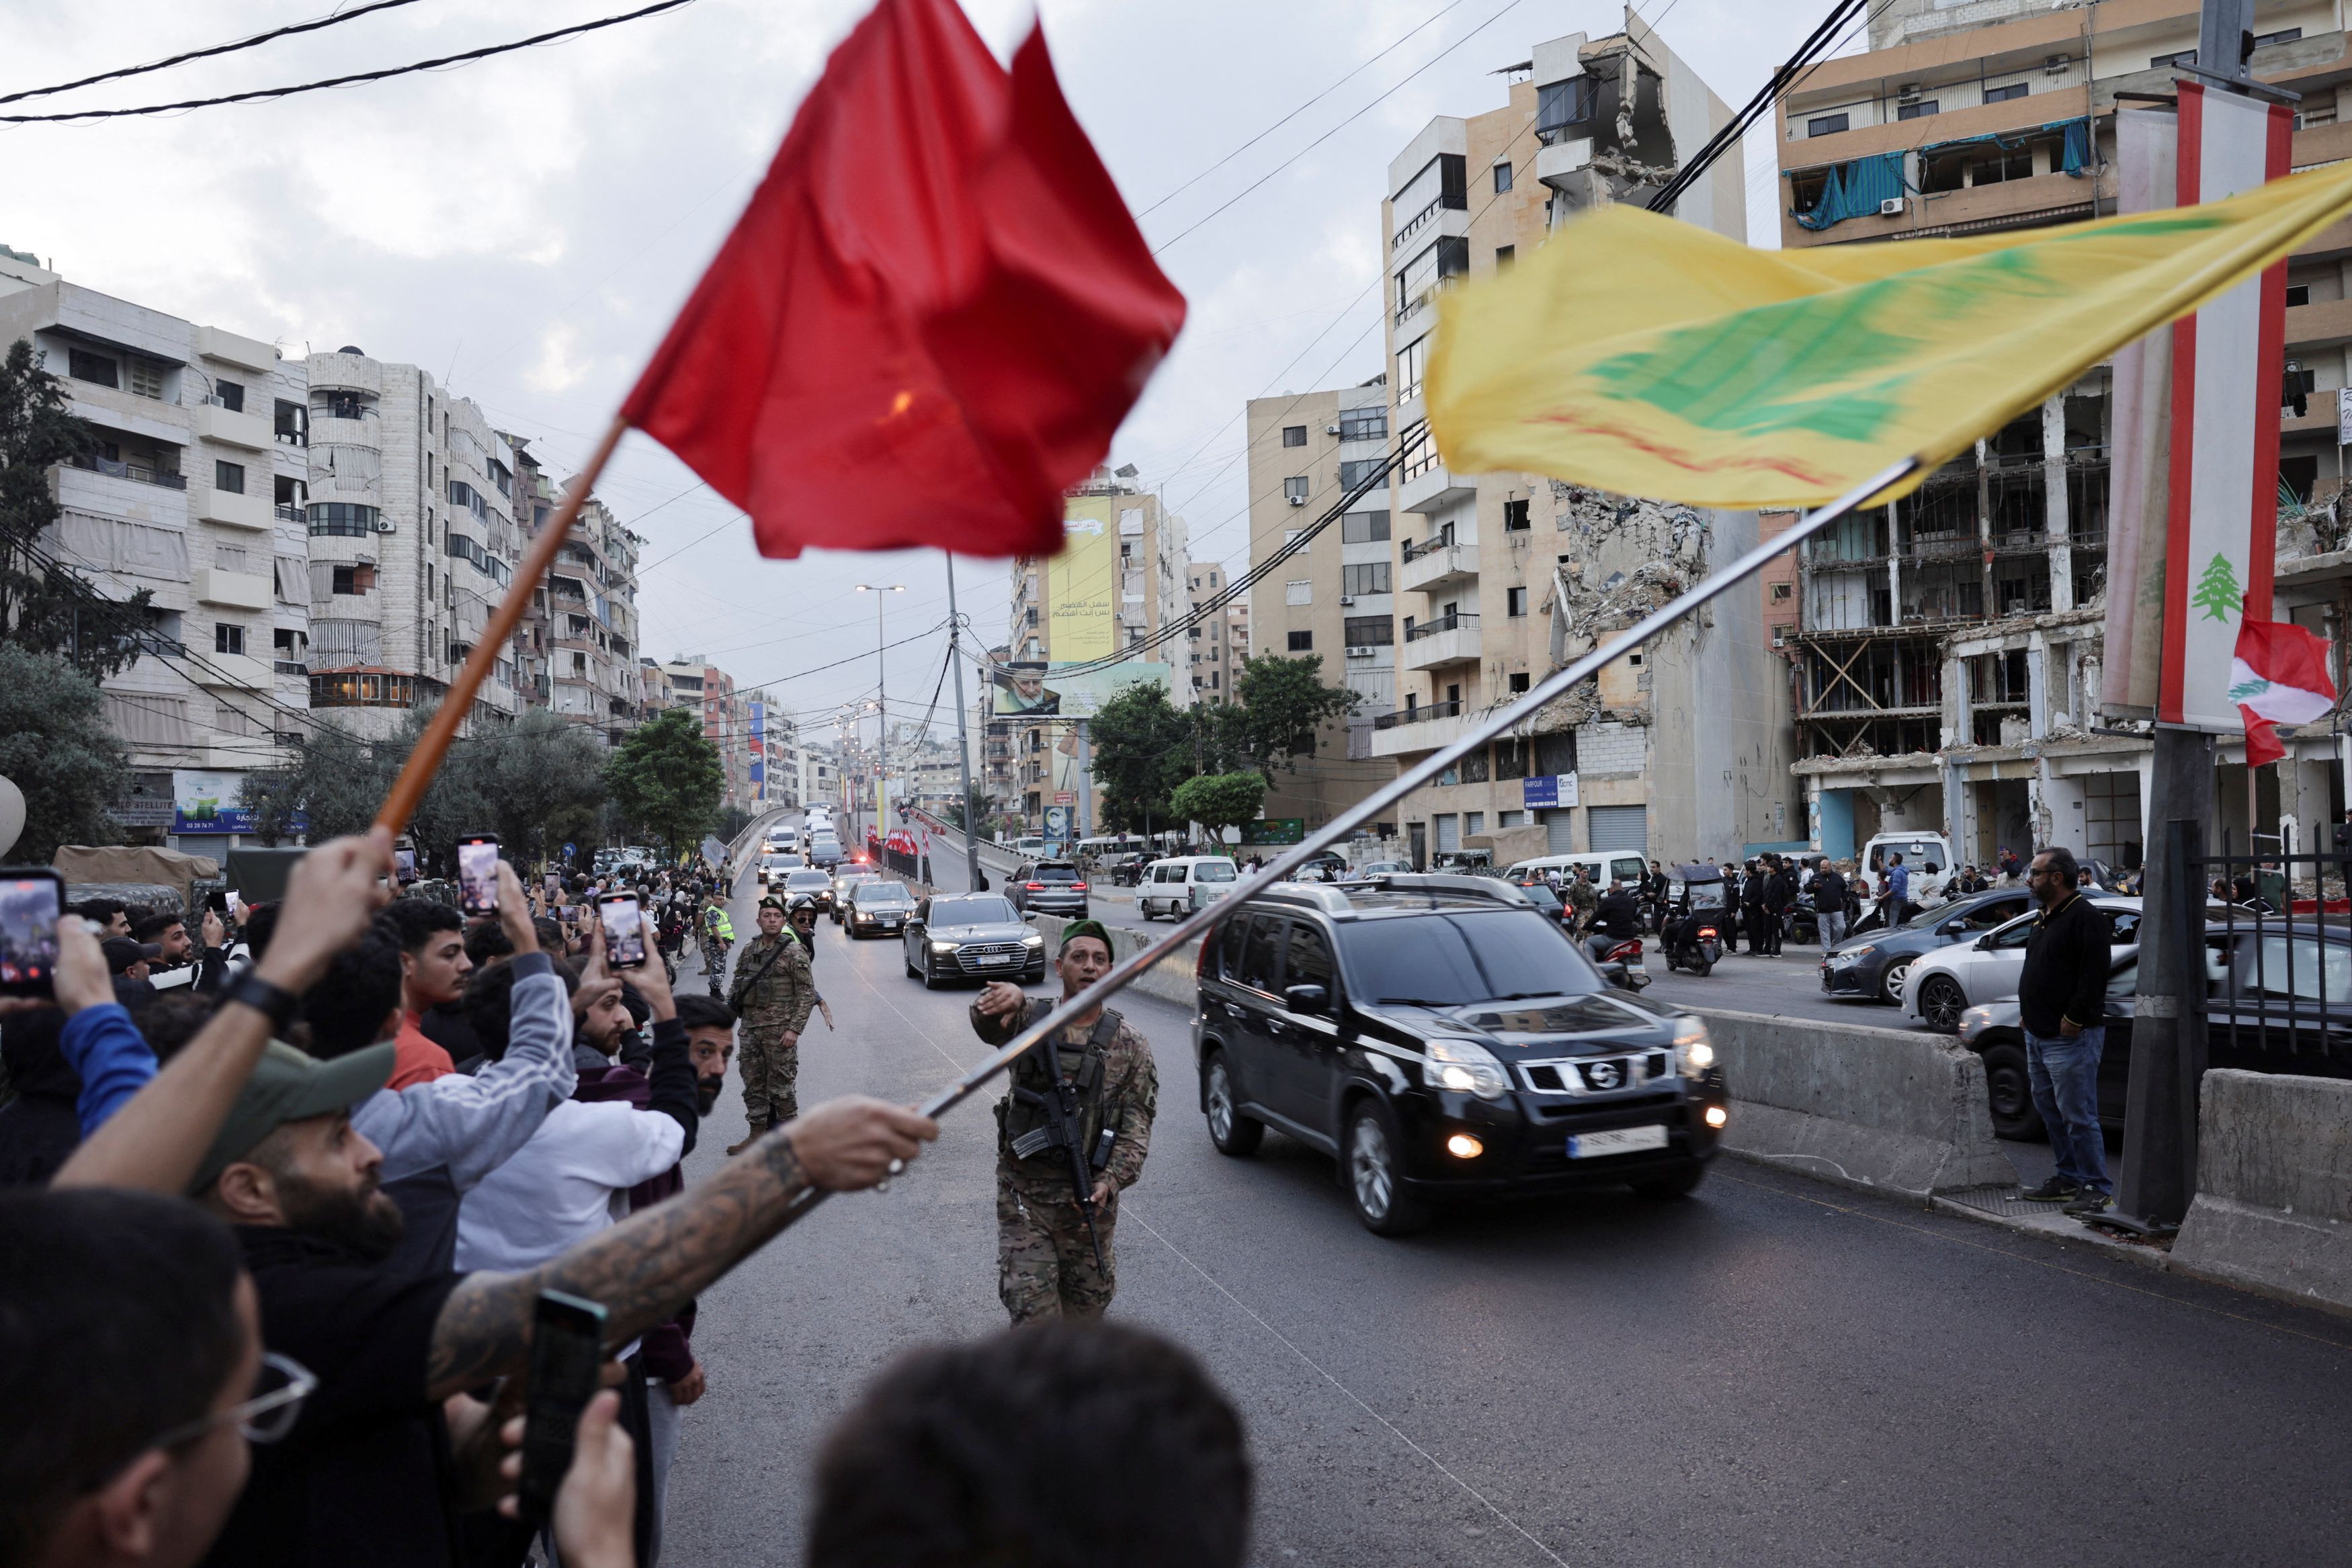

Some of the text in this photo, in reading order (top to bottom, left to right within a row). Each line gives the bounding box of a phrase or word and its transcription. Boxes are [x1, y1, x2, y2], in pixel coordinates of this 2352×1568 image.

[1052, 608, 1078, 618] أهضم
[1525, 780, 1543, 788] FARFOUR
[134, 801, 173, 810] STELLITE
